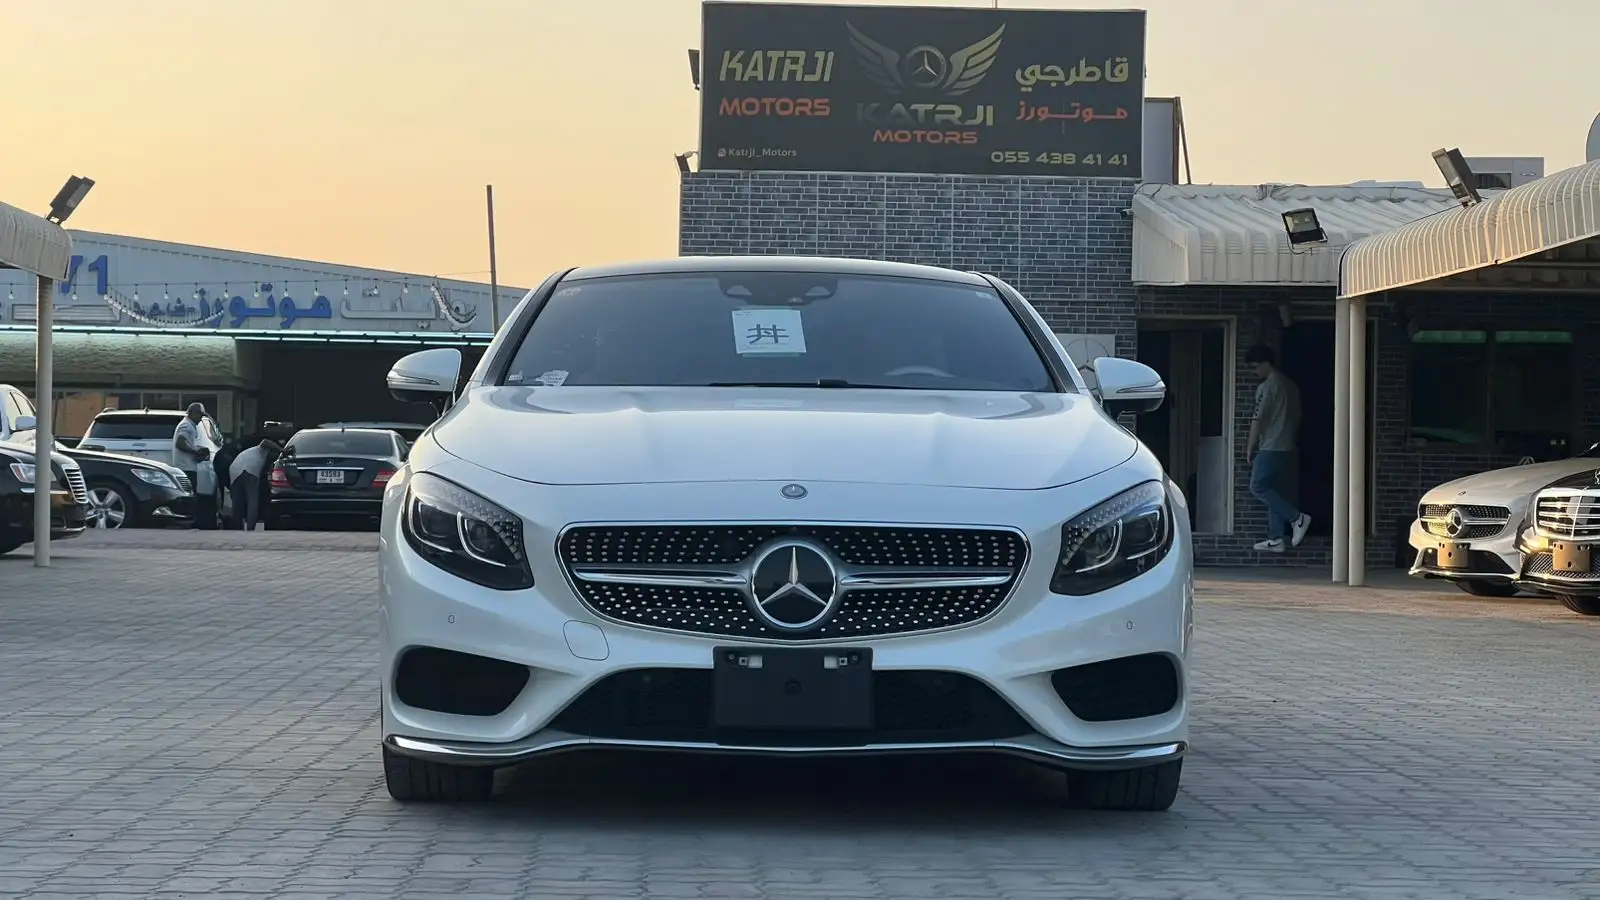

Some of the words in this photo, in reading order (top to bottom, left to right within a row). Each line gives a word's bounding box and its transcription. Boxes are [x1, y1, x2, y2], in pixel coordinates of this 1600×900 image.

[719, 49, 835, 82] KATRJI
[1015, 56, 1129, 92] قاطرجي
[718, 97, 831, 116] MOTORS
[856, 102, 995, 127] KATRJI
[872, 129, 978, 145] MOTORS
[990, 150, 1031, 164] 055
[1035, 152, 1077, 165] 438
[1081, 153, 1103, 167] 41
[1107, 153, 1128, 166] 41
